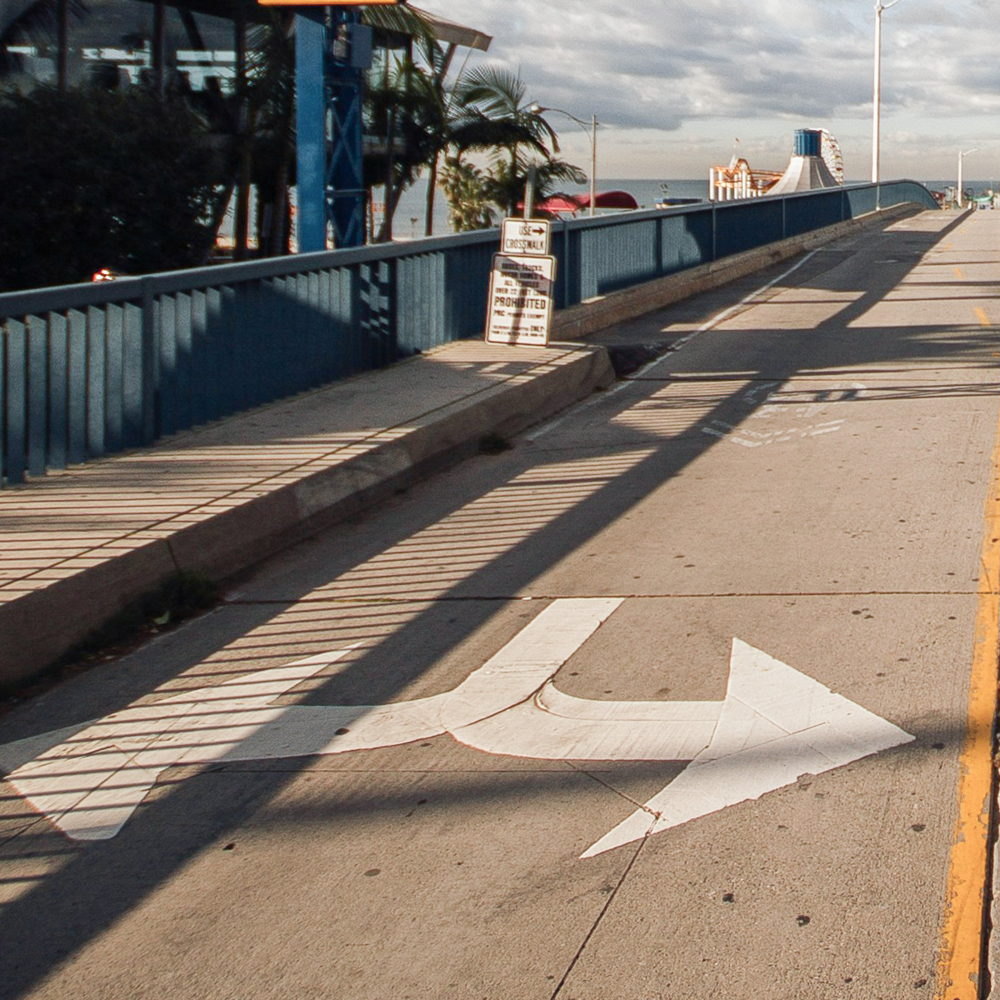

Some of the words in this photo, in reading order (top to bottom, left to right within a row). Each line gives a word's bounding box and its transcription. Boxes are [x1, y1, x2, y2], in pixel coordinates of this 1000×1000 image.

[518, 225, 532, 236] USE
[505, 238, 545, 250] CROSSWALK
[494, 296, 546, 310] PROHIBITED
